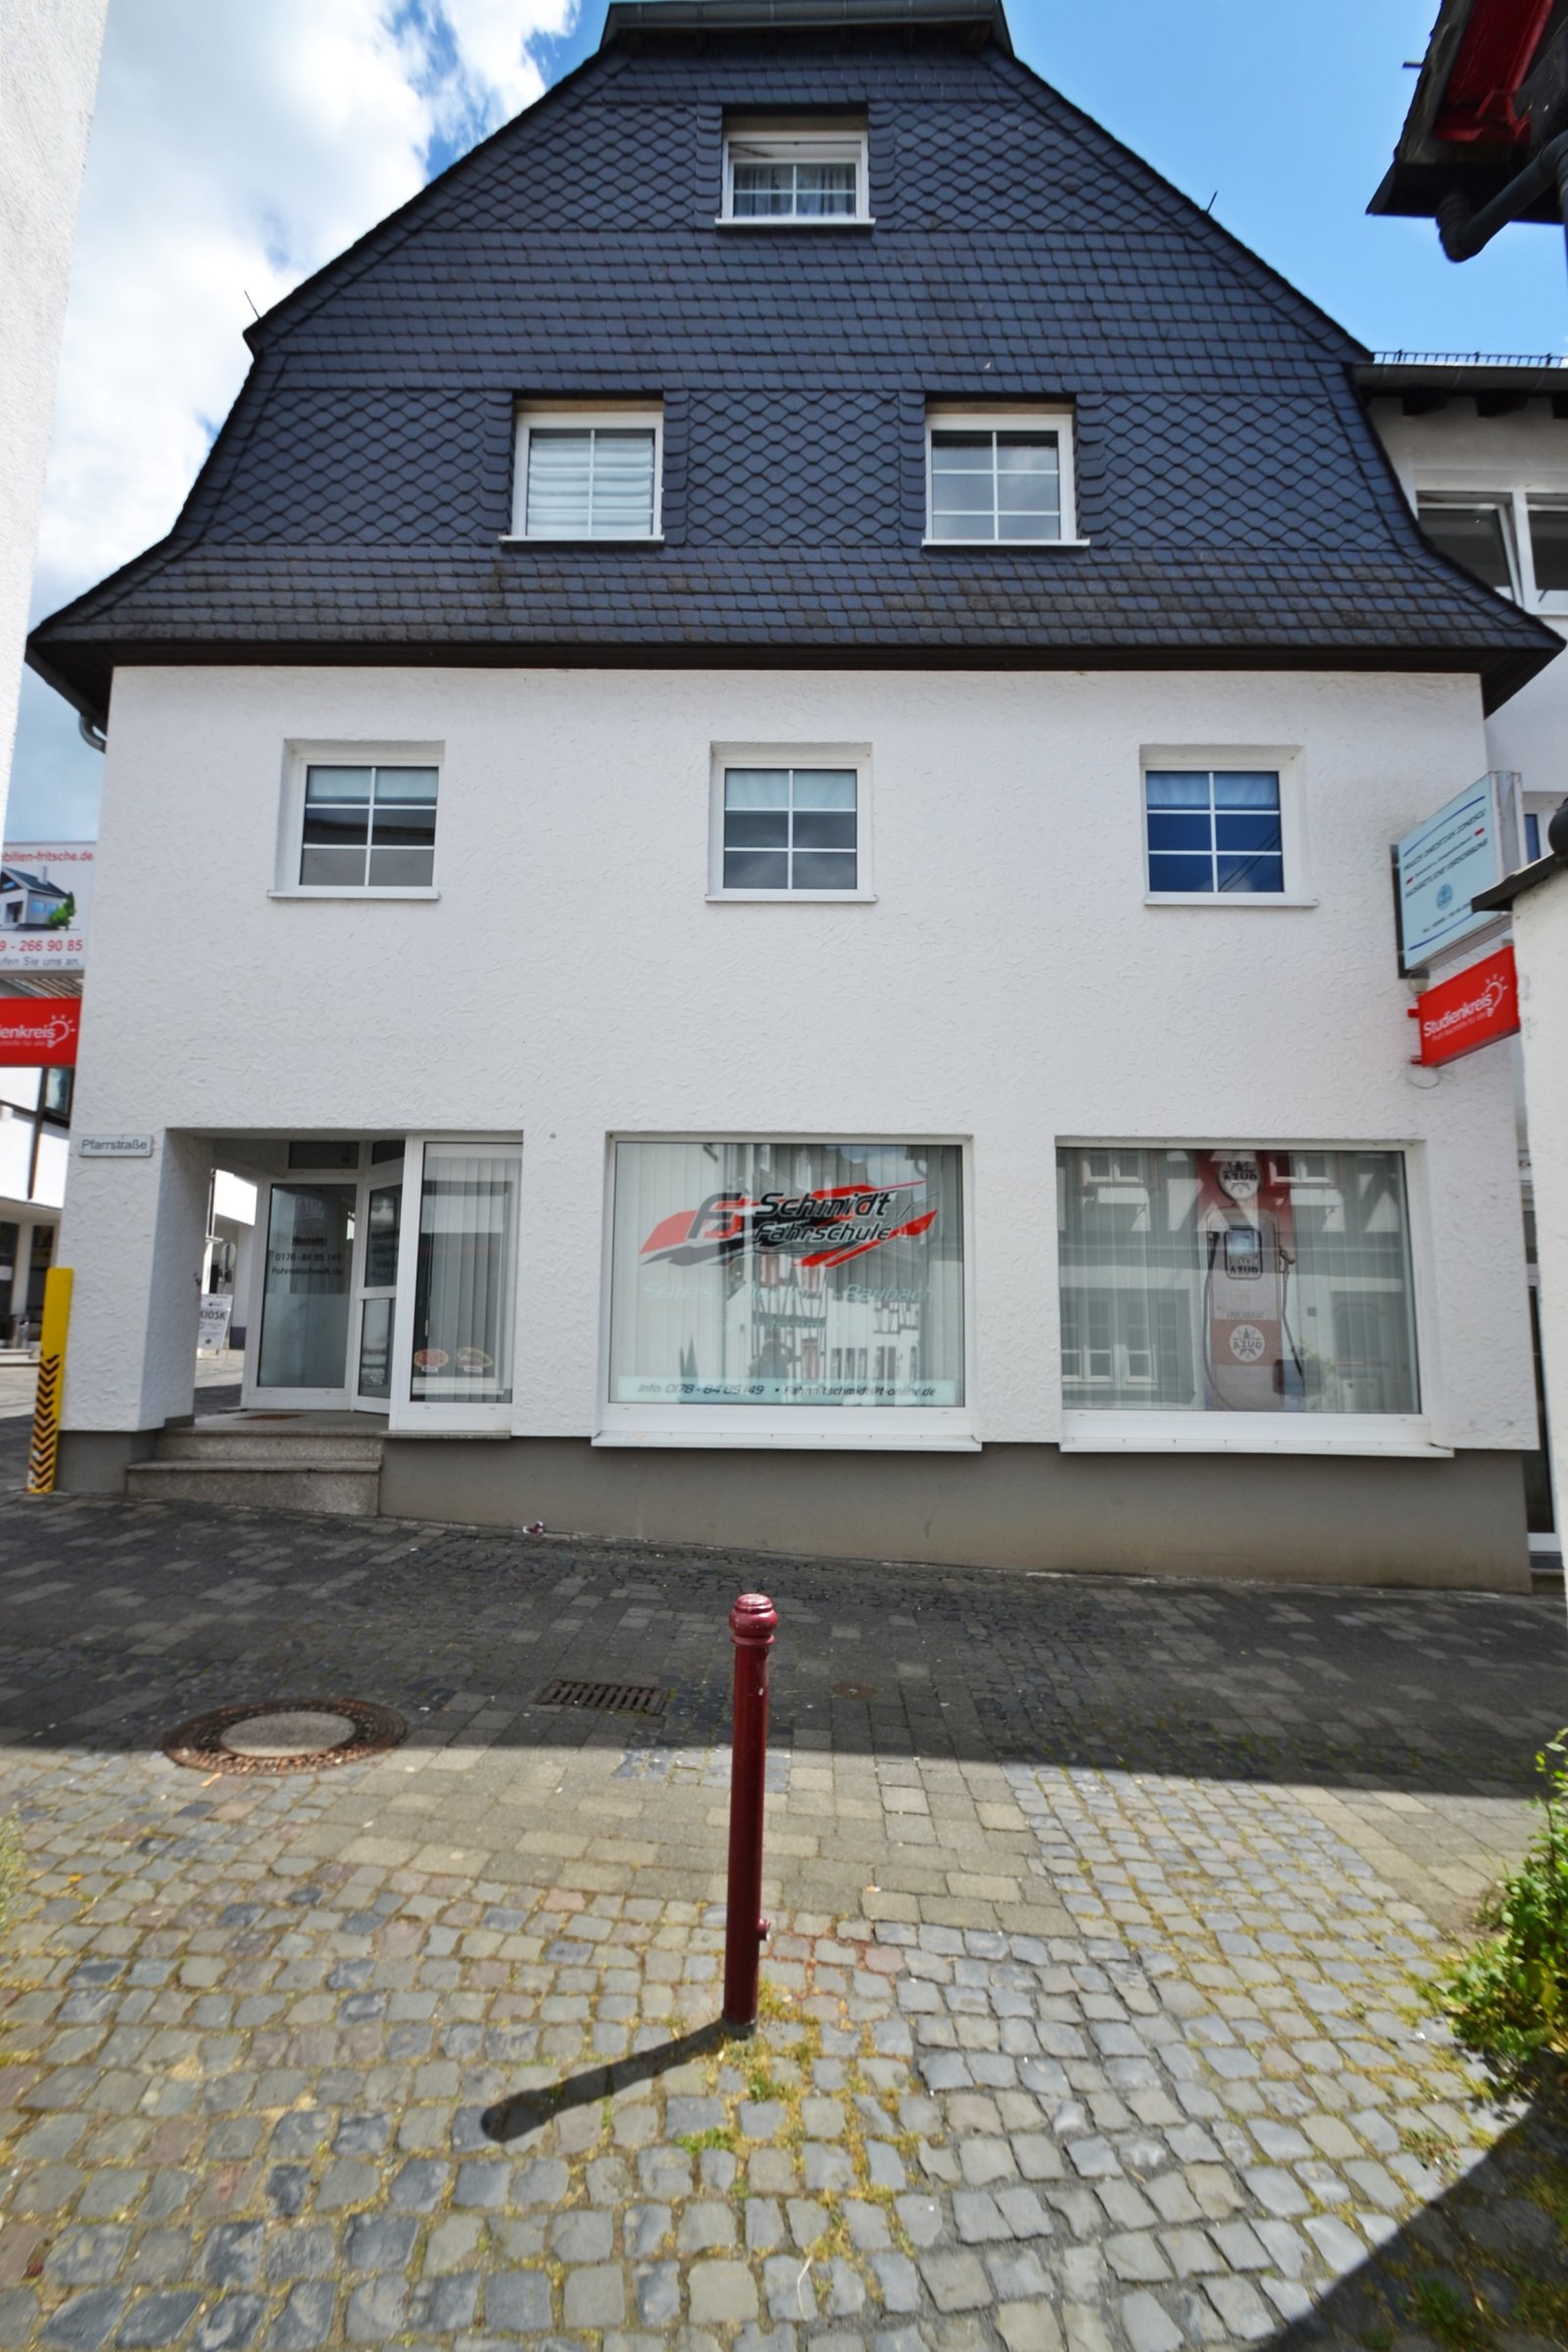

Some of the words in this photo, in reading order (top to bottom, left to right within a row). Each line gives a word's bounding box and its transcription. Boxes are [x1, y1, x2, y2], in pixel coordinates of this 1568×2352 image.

[19, 940, 43, 952] 266
[47, 940, 63, 952] 90
[67, 940, 83, 952] 85
[23, 956, 39, 966] Sie
[1423, 992, 1493, 1038] Studienkreis
[81, 1139, 147, 1151] Pfarrstraße
[758, 1191, 894, 1218] Schmidt
[754, 1221, 892, 1242] Fahrschule
